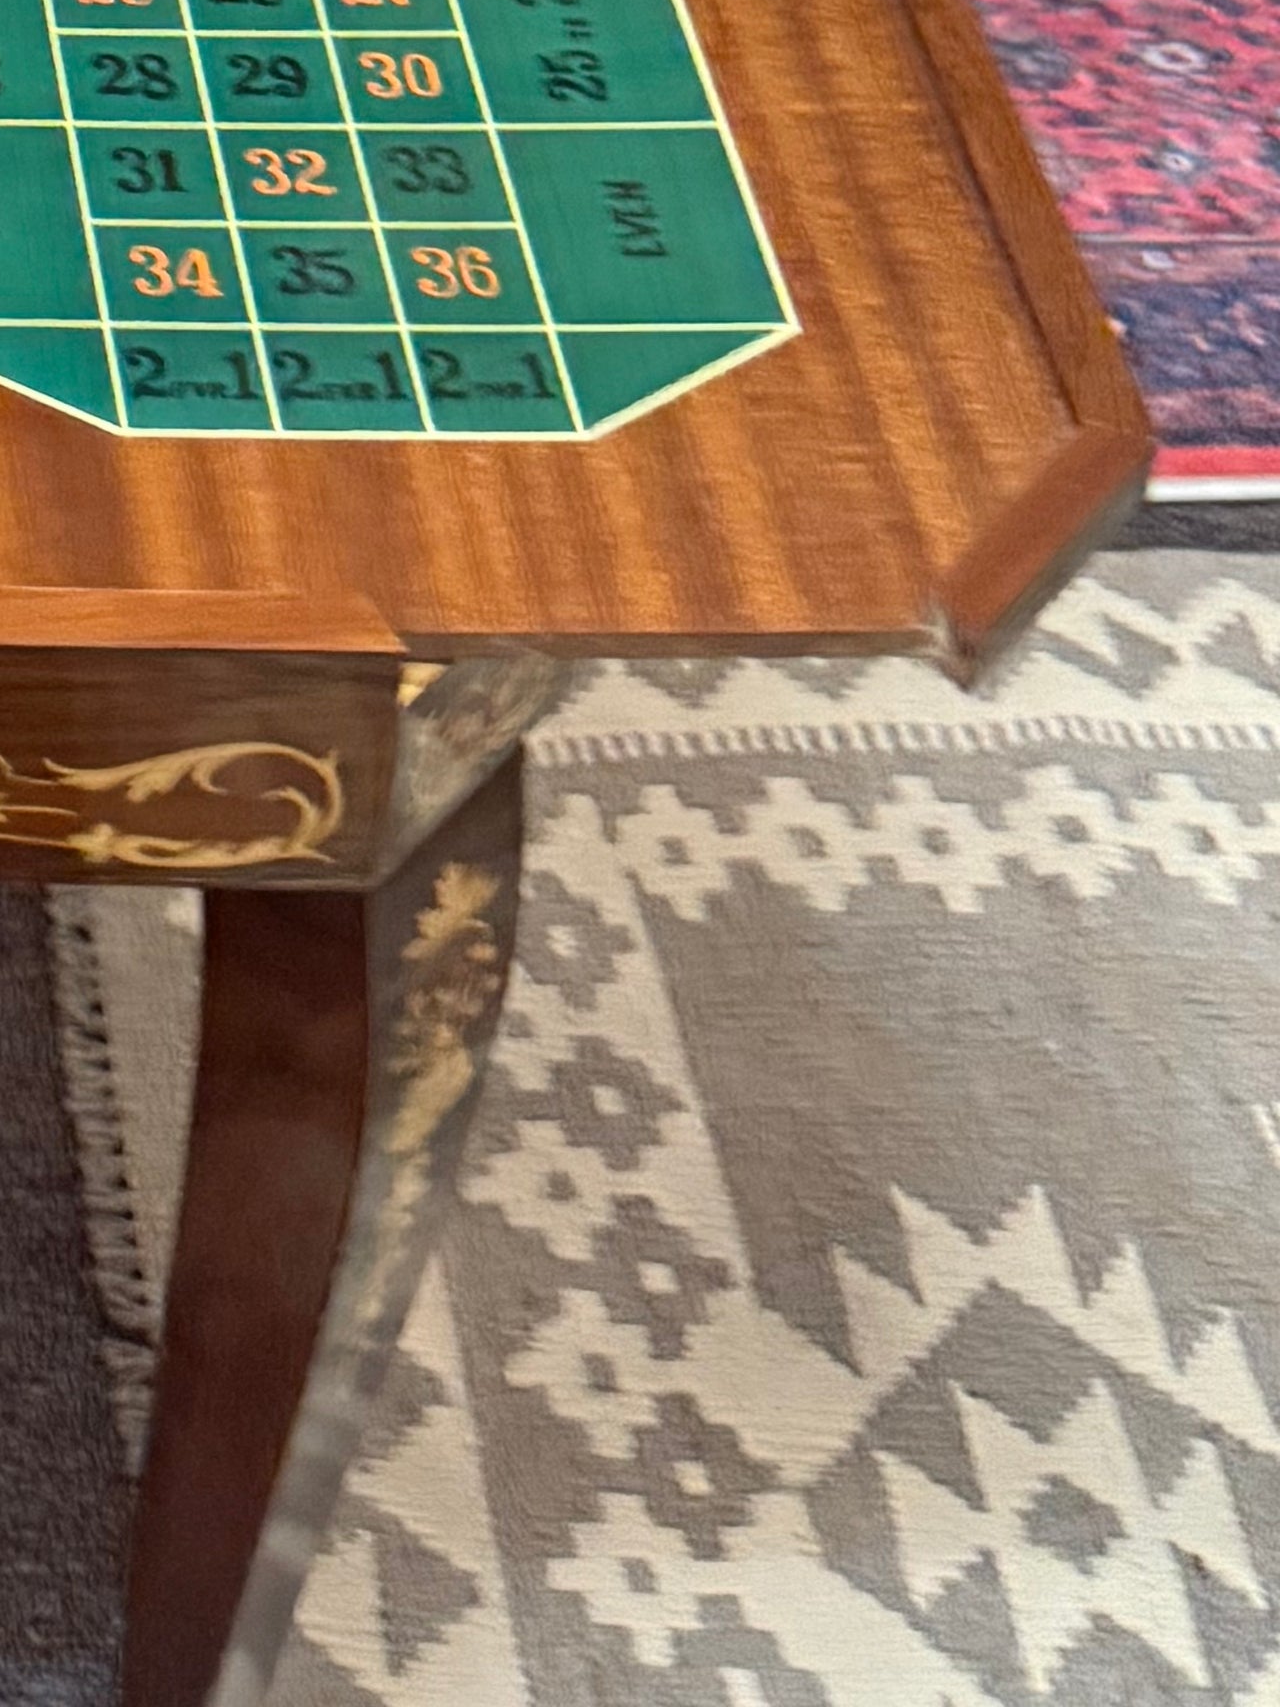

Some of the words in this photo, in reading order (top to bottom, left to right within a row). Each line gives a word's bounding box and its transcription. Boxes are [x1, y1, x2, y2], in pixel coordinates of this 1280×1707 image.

[89, 53, 179, 101] 28
[227, 53, 309, 99] 29
[359, 52, 441, 99] 30
[111, 146, 188, 194] 31
[244, 148, 335, 196] 32
[386, 145, 472, 196] 33
[128, 245, 221, 299] 34
[268, 245, 357, 297] 35
[411, 247, 499, 299] 36
[125, 346, 167, 398] 2
[274, 349, 312, 399] 2
[422, 349, 467, 399] 2
